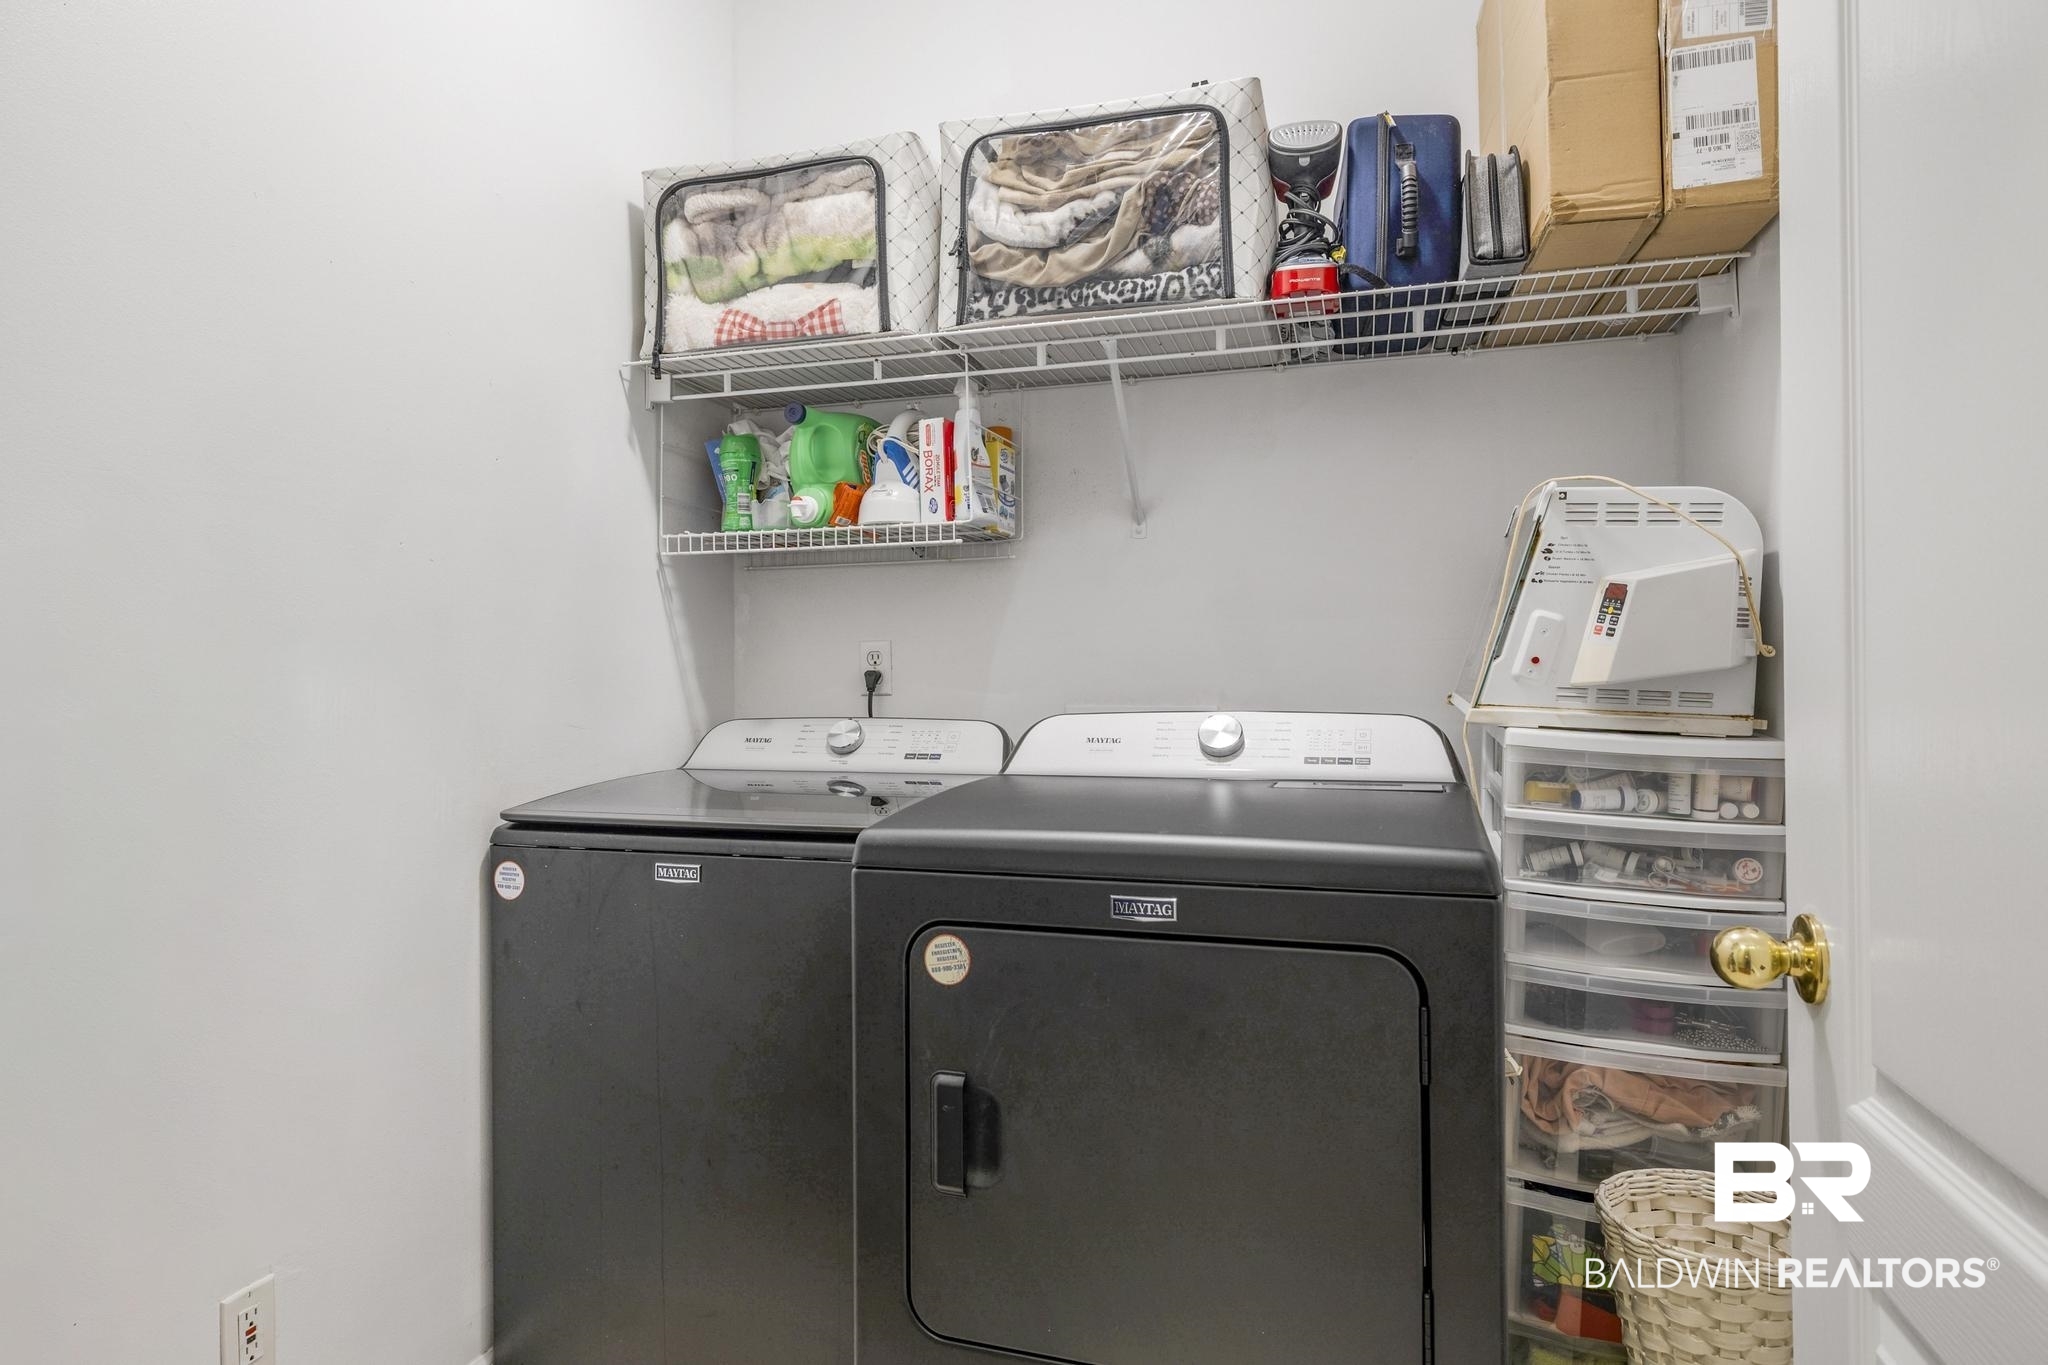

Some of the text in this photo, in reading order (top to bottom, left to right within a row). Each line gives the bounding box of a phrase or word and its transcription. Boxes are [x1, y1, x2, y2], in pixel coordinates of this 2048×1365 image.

[923, 450, 934, 493] BORAX
[1085, 737, 1122, 745] MAYTAG
[658, 867, 697, 880] MAYTAG
[1115, 900, 1173, 917] MAYTAG
